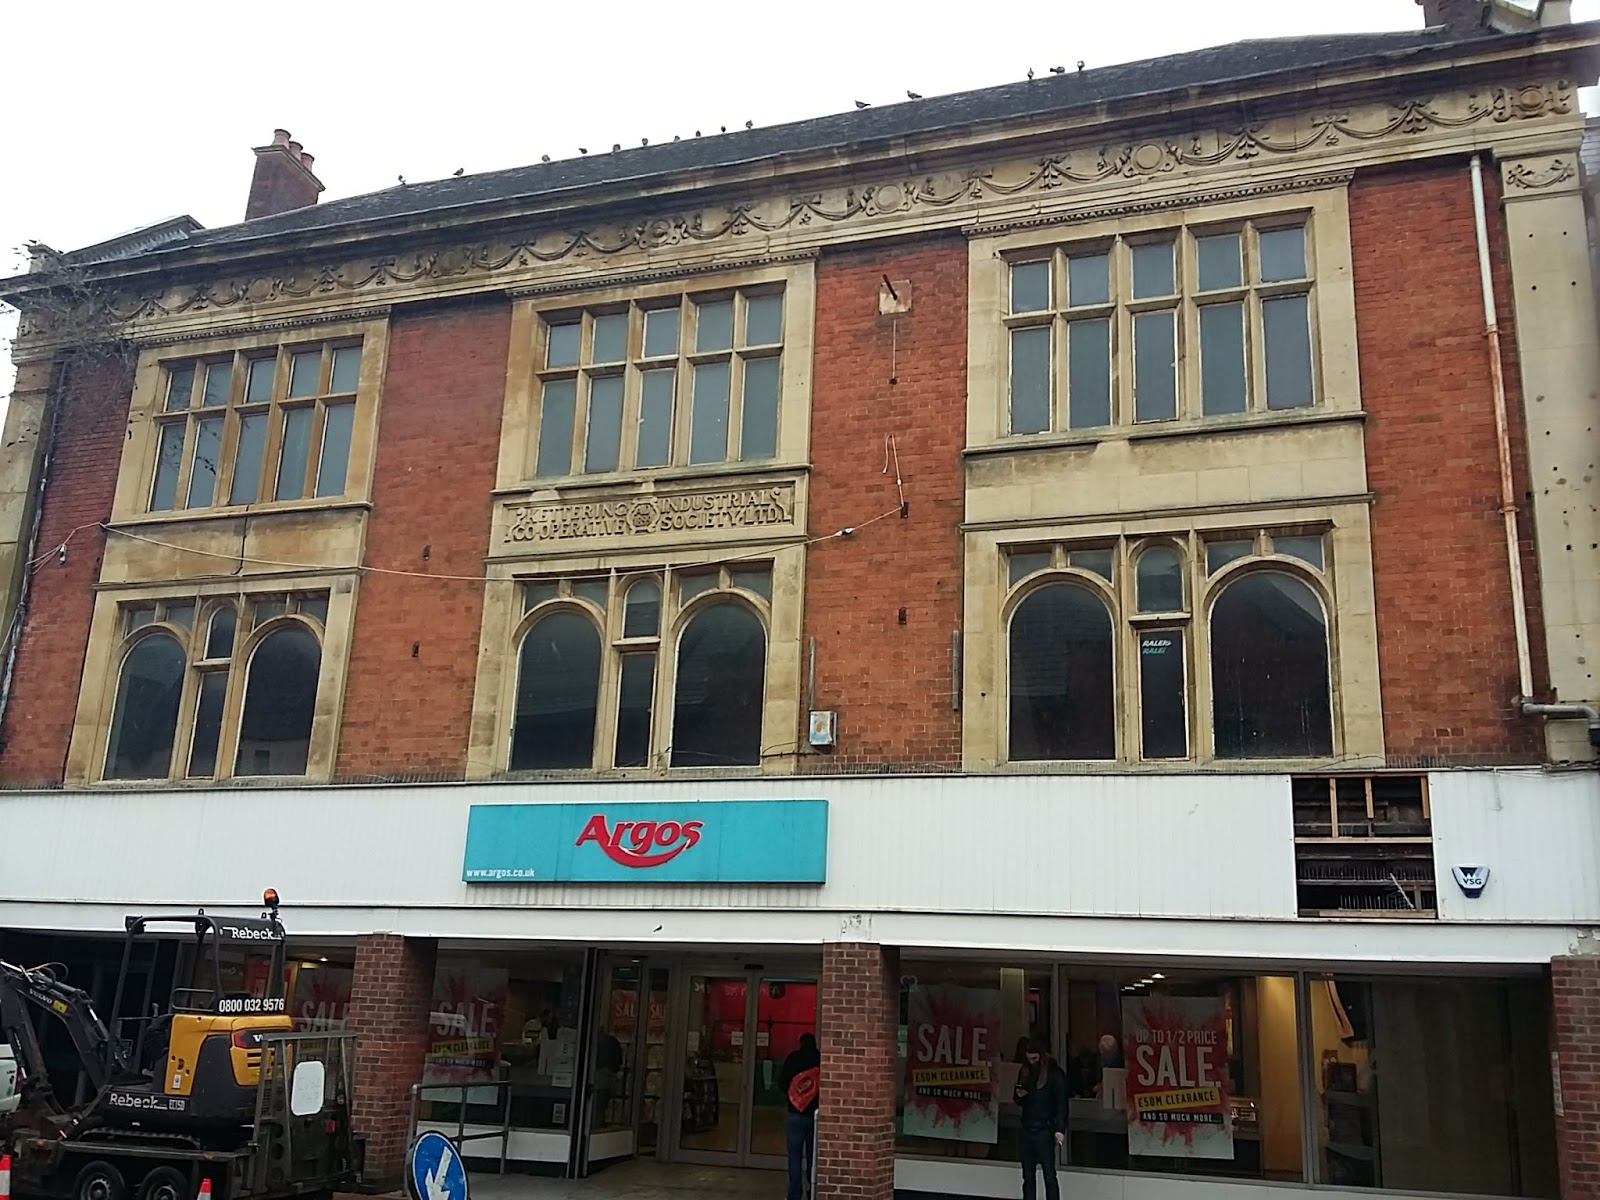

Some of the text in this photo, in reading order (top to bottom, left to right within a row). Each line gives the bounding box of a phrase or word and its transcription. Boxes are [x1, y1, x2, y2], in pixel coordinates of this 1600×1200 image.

[525, 490, 771, 524] KETTERING INDUSTRIAL
[513, 519, 626, 541] CO-OPERATIVE
[660, 510, 741, 532] SOCIETY
[575, 814, 704, 858] Argos
[467, 868, 535, 879] www.argos.co.uk
[231, 926, 274, 940] Rebeck
[29, 987, 53, 1005] VOLVO
[218, 997, 285, 1013] 0800 032 9576
[1135, 1029, 1217, 1045] UP TO 1/2 PRICE
[918, 1086, 932, 1095] AND
[108, 1092, 159, 1109] Rebeck
[1142, 1112, 1157, 1121] AND
[1158, 1112, 1169, 1121] SO
[1170, 1112, 1191, 1122] MUCH
